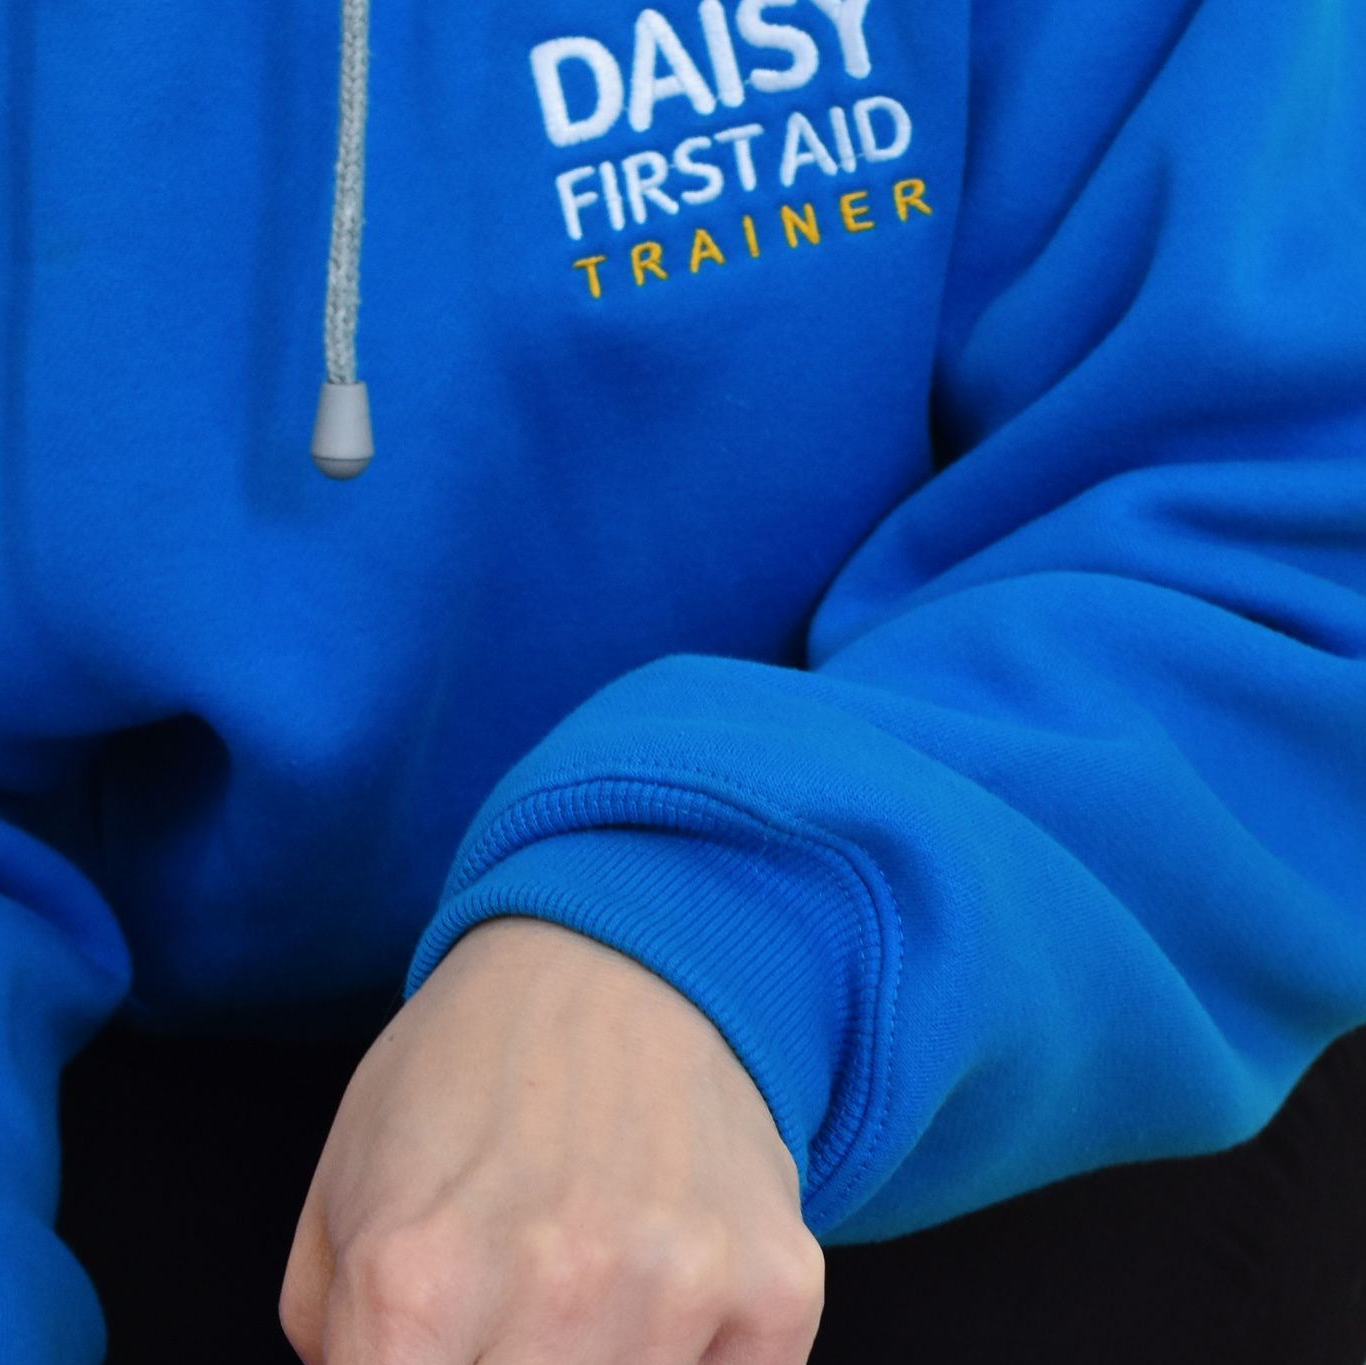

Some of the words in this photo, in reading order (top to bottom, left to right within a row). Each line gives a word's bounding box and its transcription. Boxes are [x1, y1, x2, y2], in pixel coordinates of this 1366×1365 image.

[530, 0, 871, 147] DAISY
[555, 123, 764, 240] FIRST
[780, 96, 912, 187] AID
[573, 178, 932, 299] TRAINER
